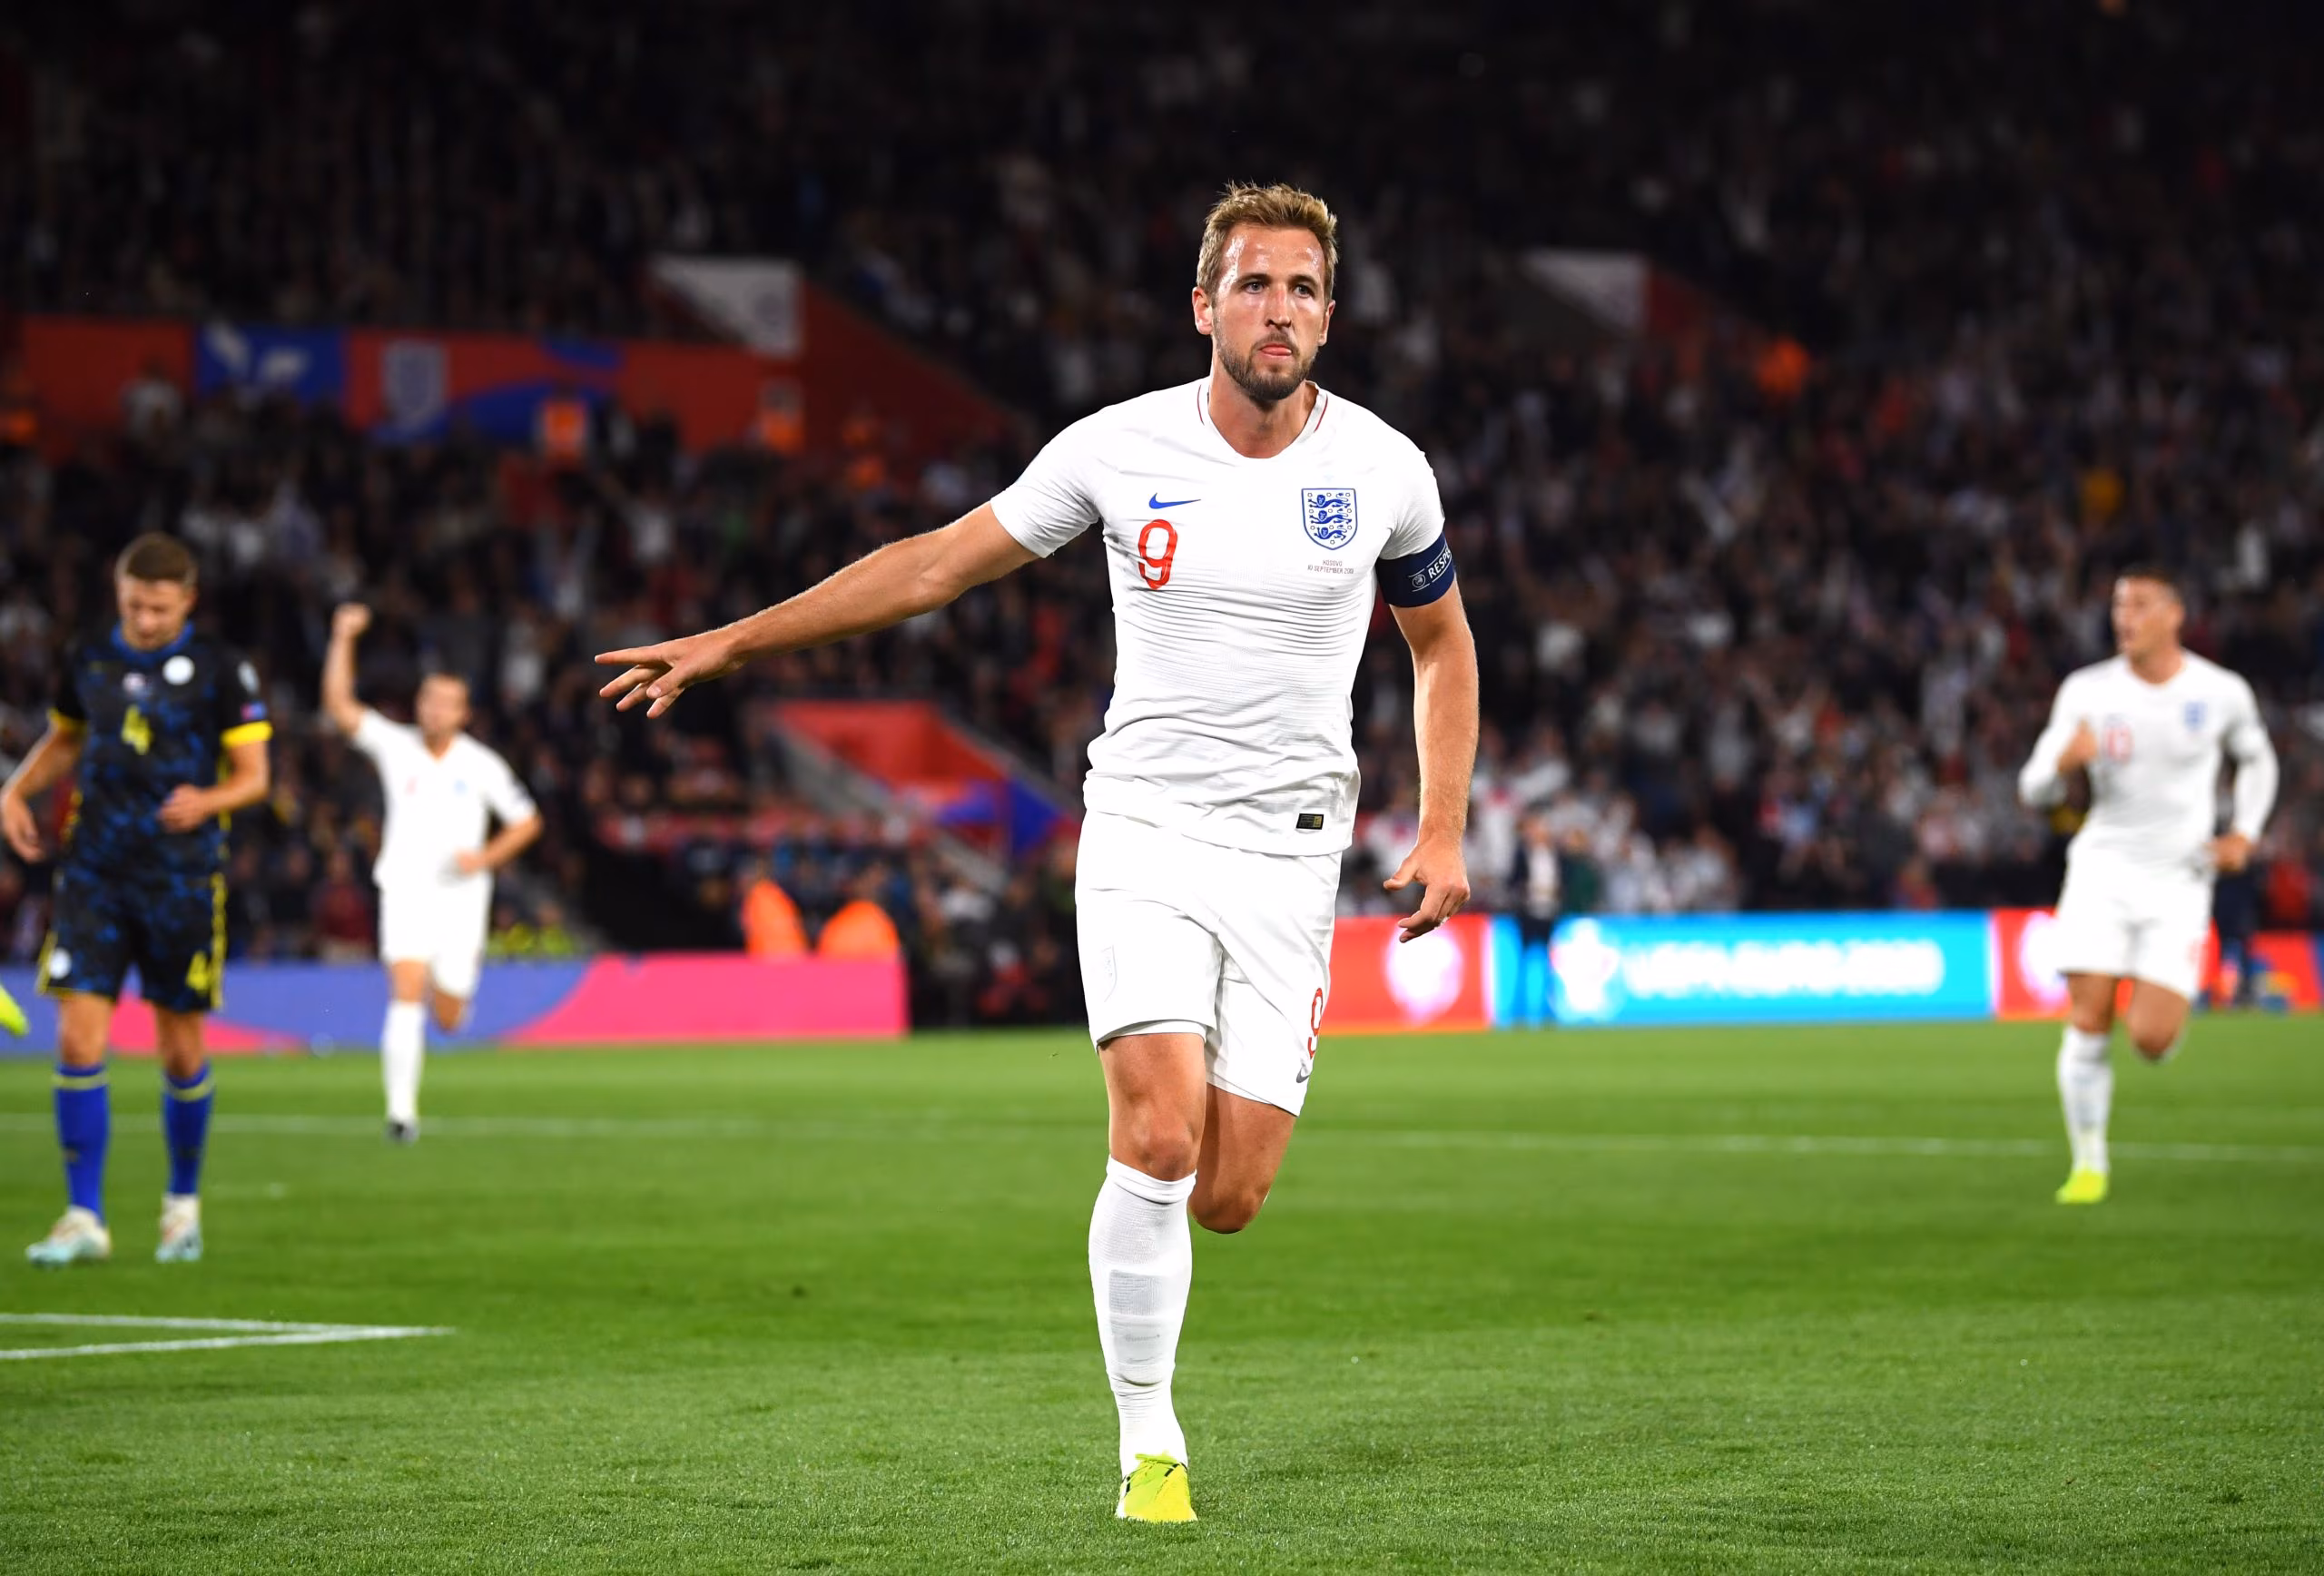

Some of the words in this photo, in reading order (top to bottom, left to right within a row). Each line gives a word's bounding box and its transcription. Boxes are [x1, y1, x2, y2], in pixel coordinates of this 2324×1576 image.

[1137, 519, 1177, 591] 9
[1314, 565, 1343, 574] SEPTEMBER
[122, 704, 153, 755] 4
[185, 951, 209, 996] 4
[1307, 988, 1324, 1059] 9
